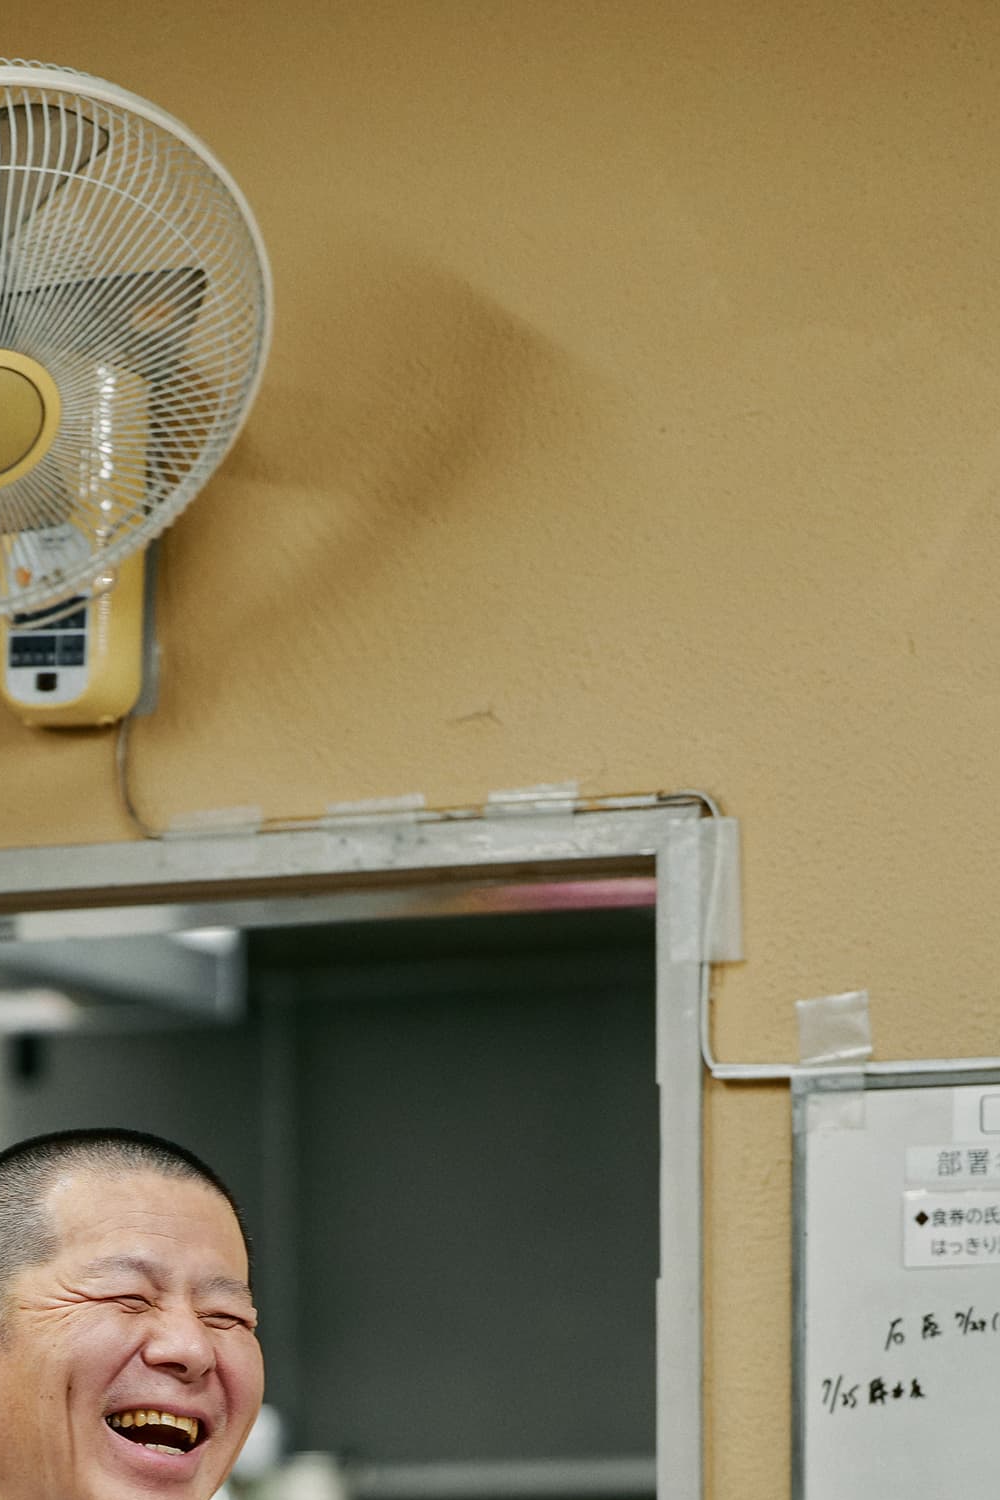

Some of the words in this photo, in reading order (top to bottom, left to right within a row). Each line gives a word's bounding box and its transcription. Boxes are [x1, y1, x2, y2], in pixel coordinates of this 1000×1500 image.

[937, 1148, 1000, 1177] 部署
[931, 1235, 1000, 1256] はっきり
